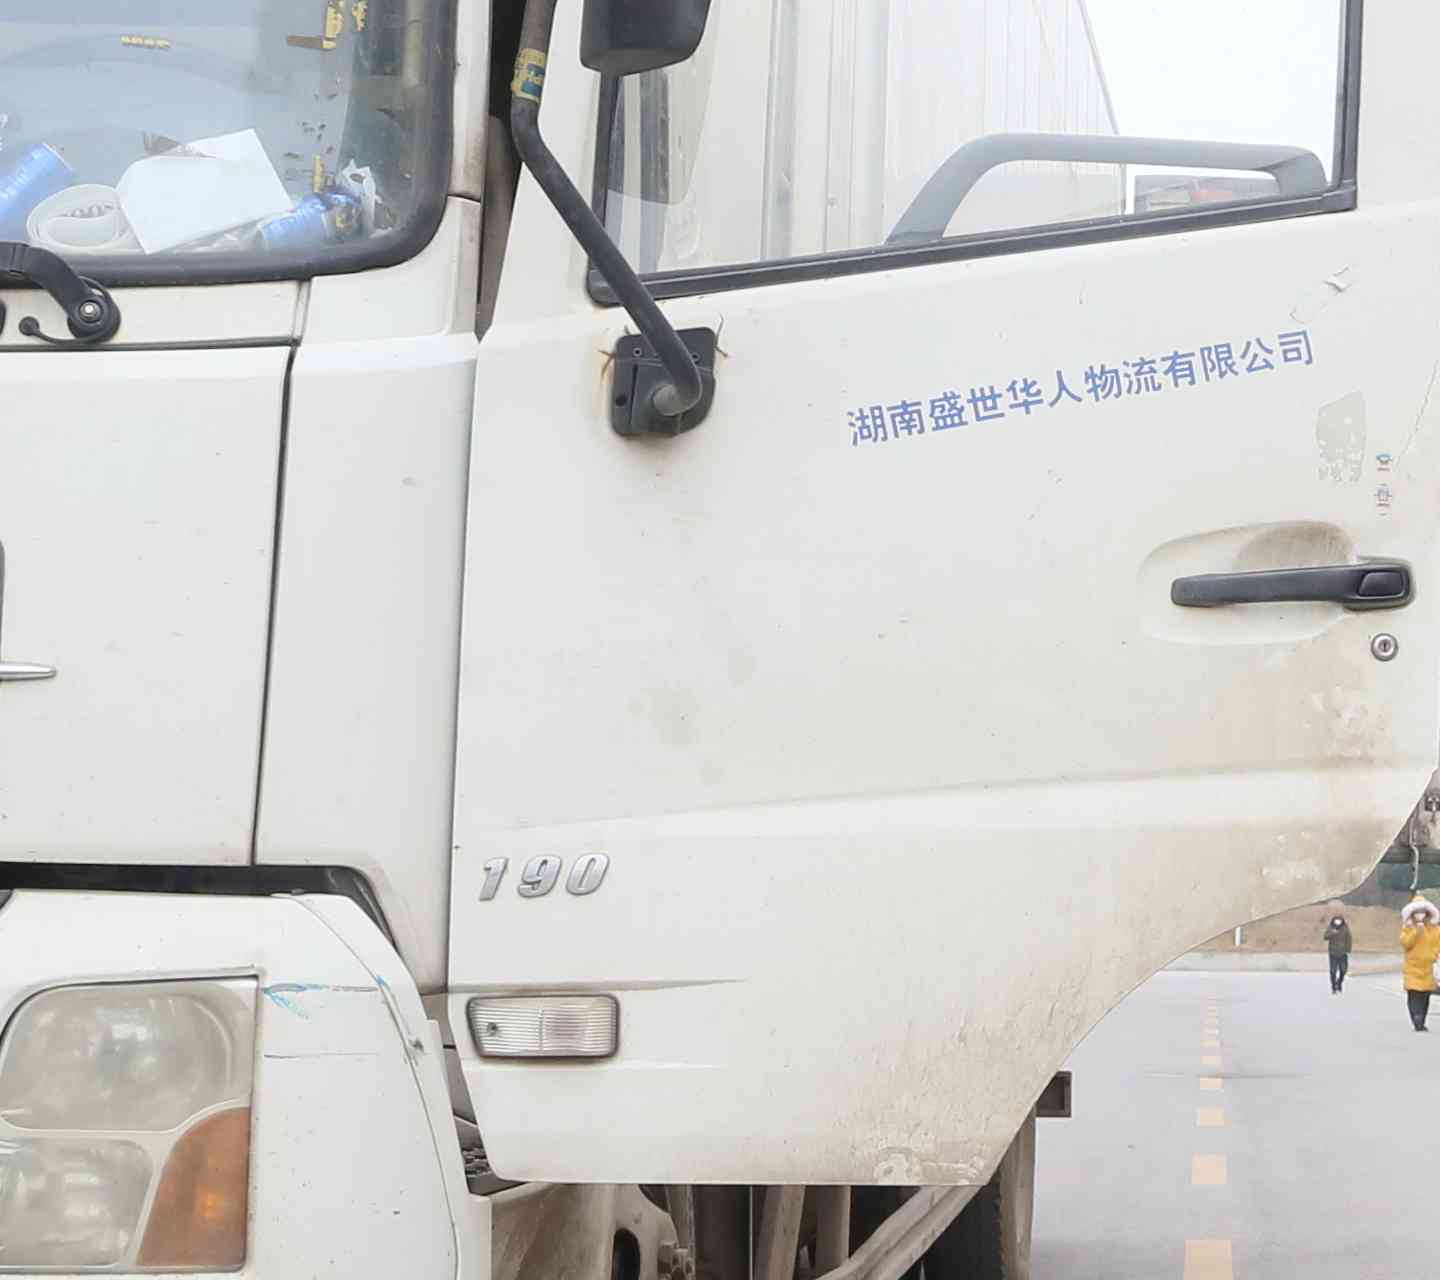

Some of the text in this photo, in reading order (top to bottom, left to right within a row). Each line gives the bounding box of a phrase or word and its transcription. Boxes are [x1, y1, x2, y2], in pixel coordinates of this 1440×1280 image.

[847, 329, 1314, 446] 湖南盛世华人物流有限公司
[479, 852, 611, 902] 190
